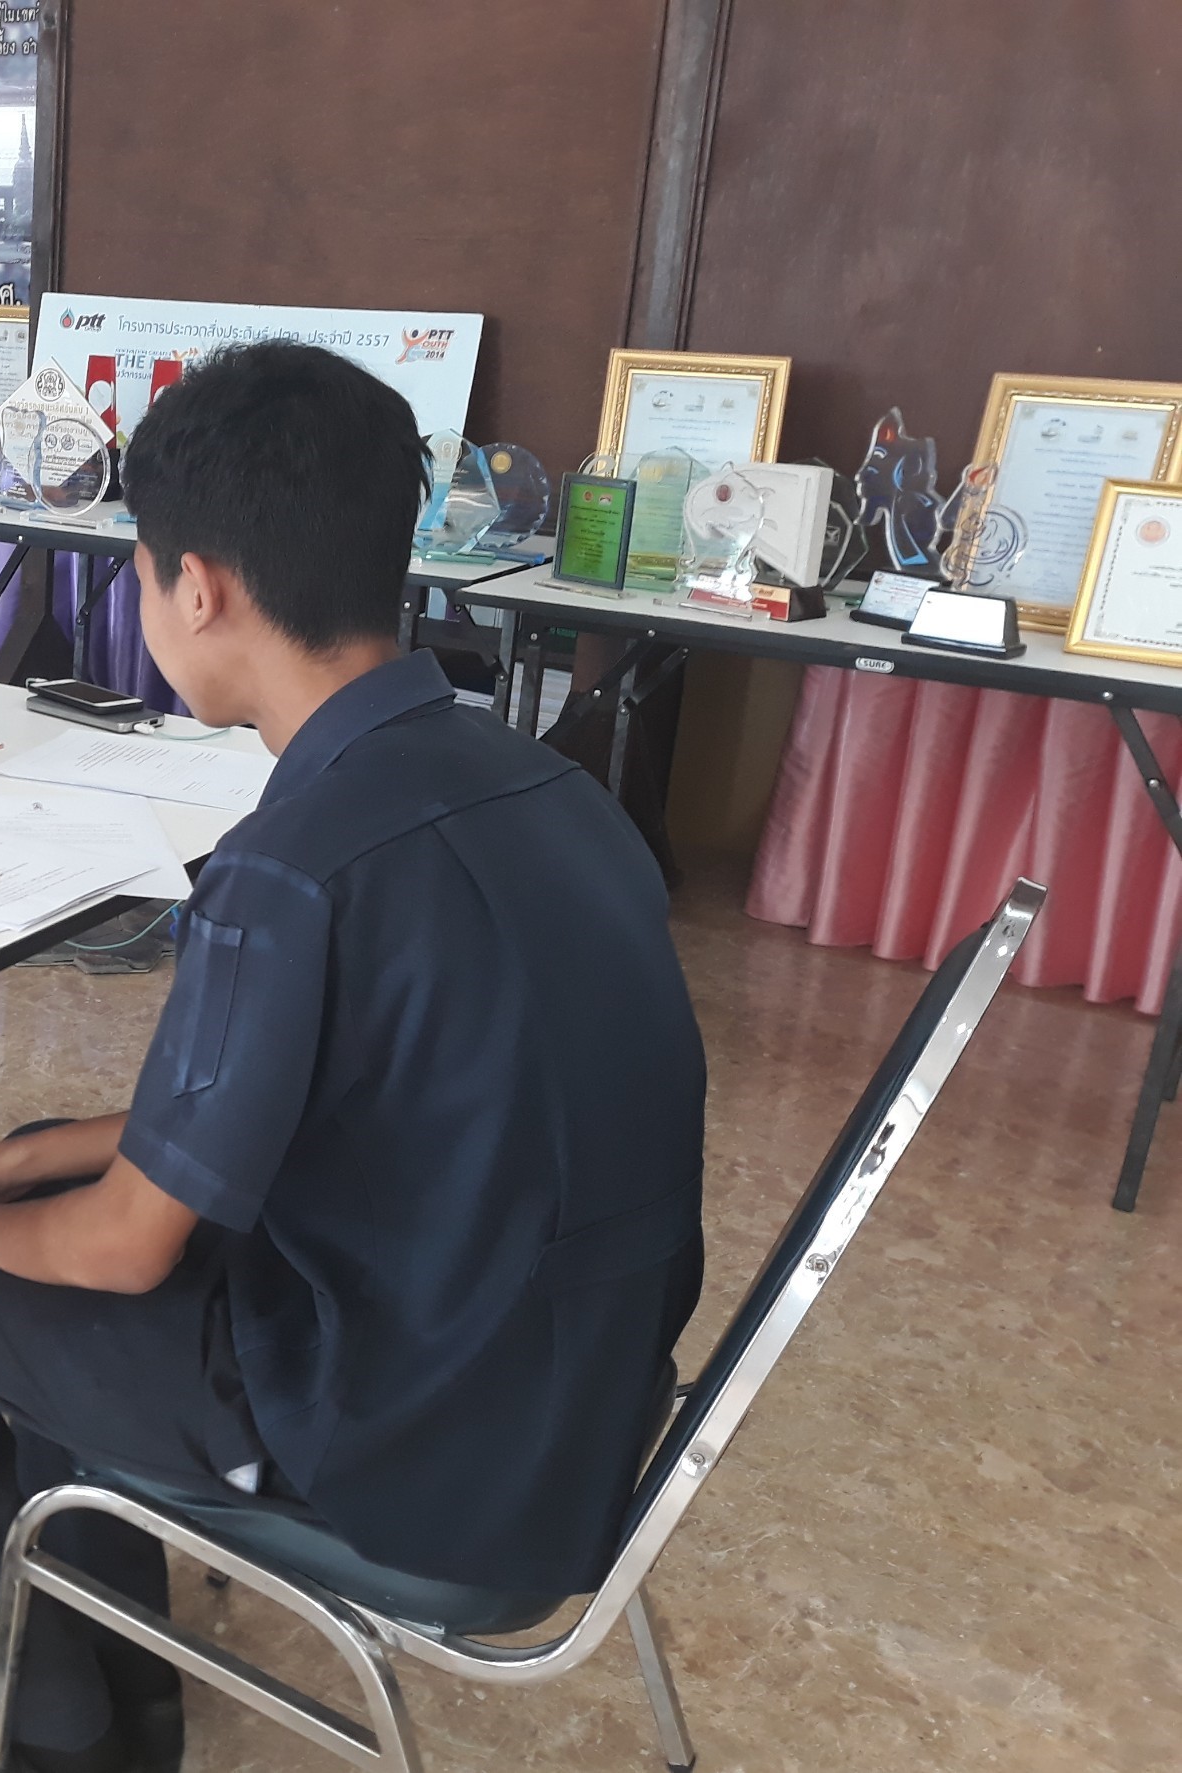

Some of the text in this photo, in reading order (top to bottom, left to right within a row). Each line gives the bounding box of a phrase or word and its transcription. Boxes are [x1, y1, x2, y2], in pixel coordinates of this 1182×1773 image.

[74, 313, 106, 331] ptt
[307, 329, 352, 345] ประจำปี
[356, 333, 390, 347] 2557
[428, 329, 455, 340] PTT
[115, 353, 146, 369] THE
[425, 350, 445, 359] 2014
